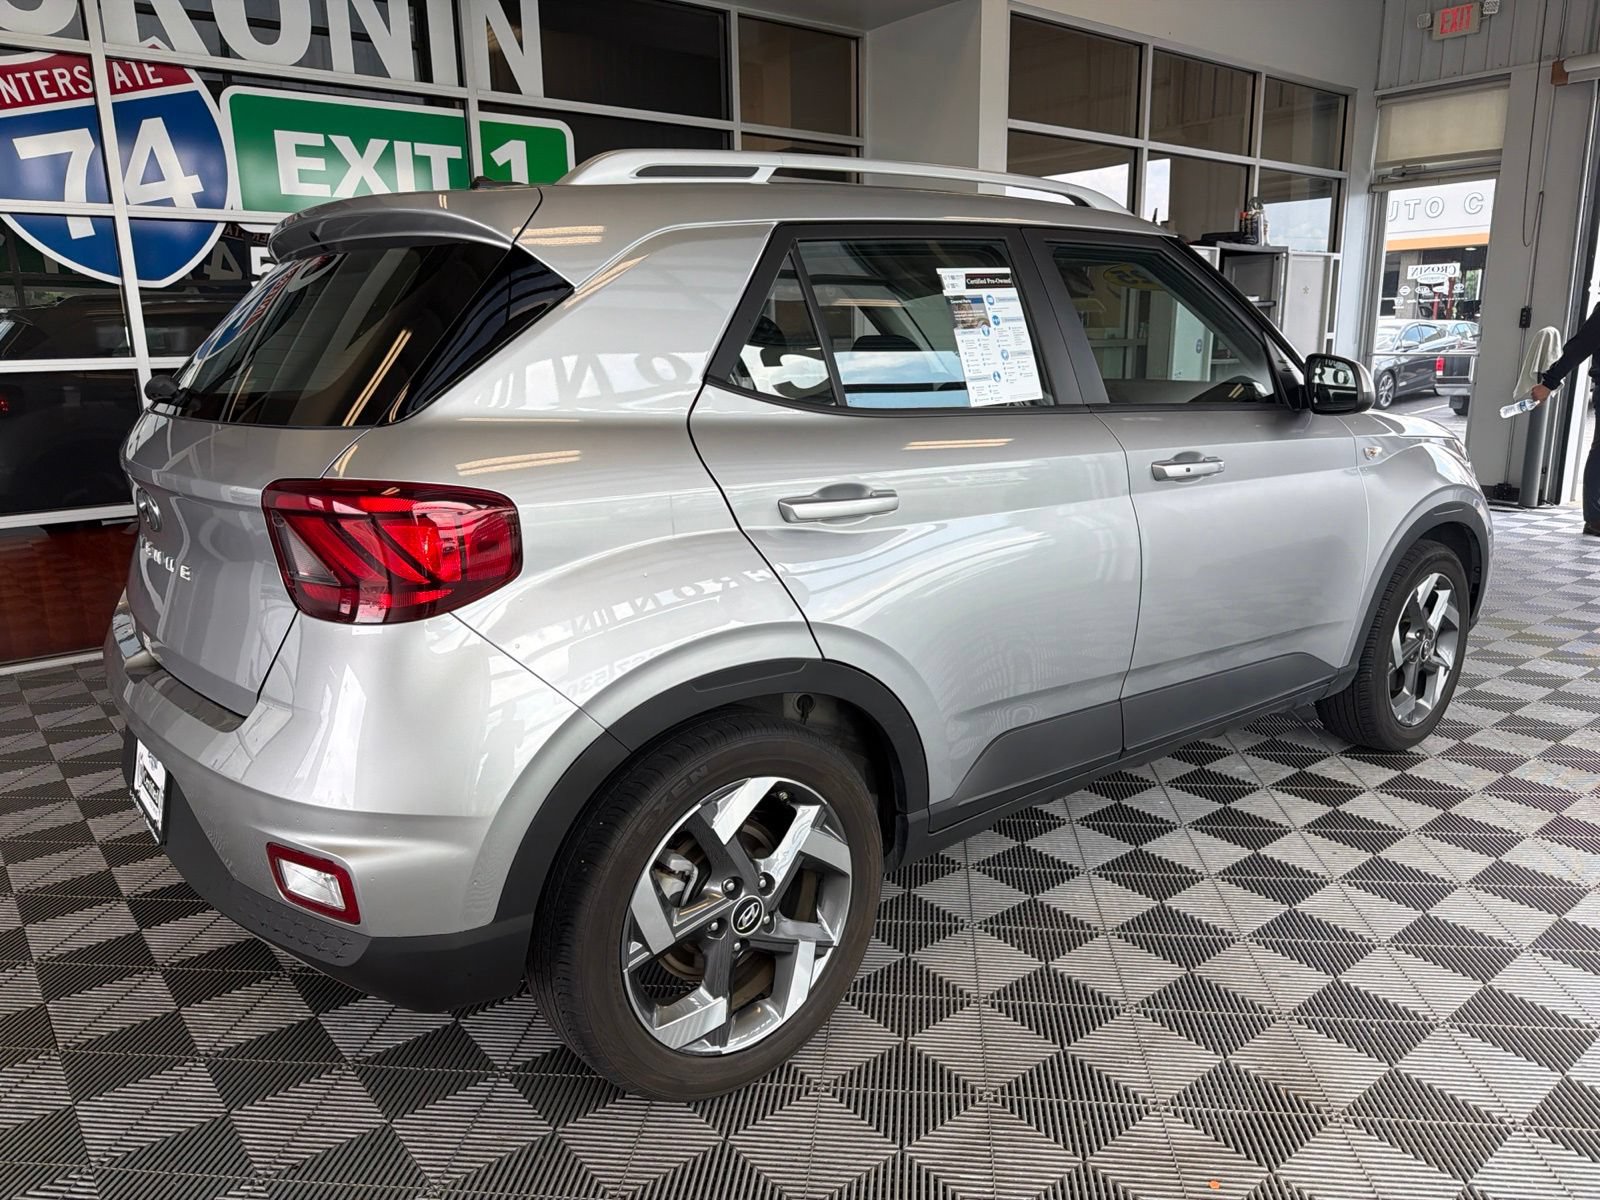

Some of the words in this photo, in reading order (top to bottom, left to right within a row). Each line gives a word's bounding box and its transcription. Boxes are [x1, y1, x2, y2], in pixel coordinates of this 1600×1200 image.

[1439, 4, 1474, 35] EXIT
[12, 116, 205, 240] 74
[273, 129, 463, 198] EXIT
[488, 139, 530, 184] 1
